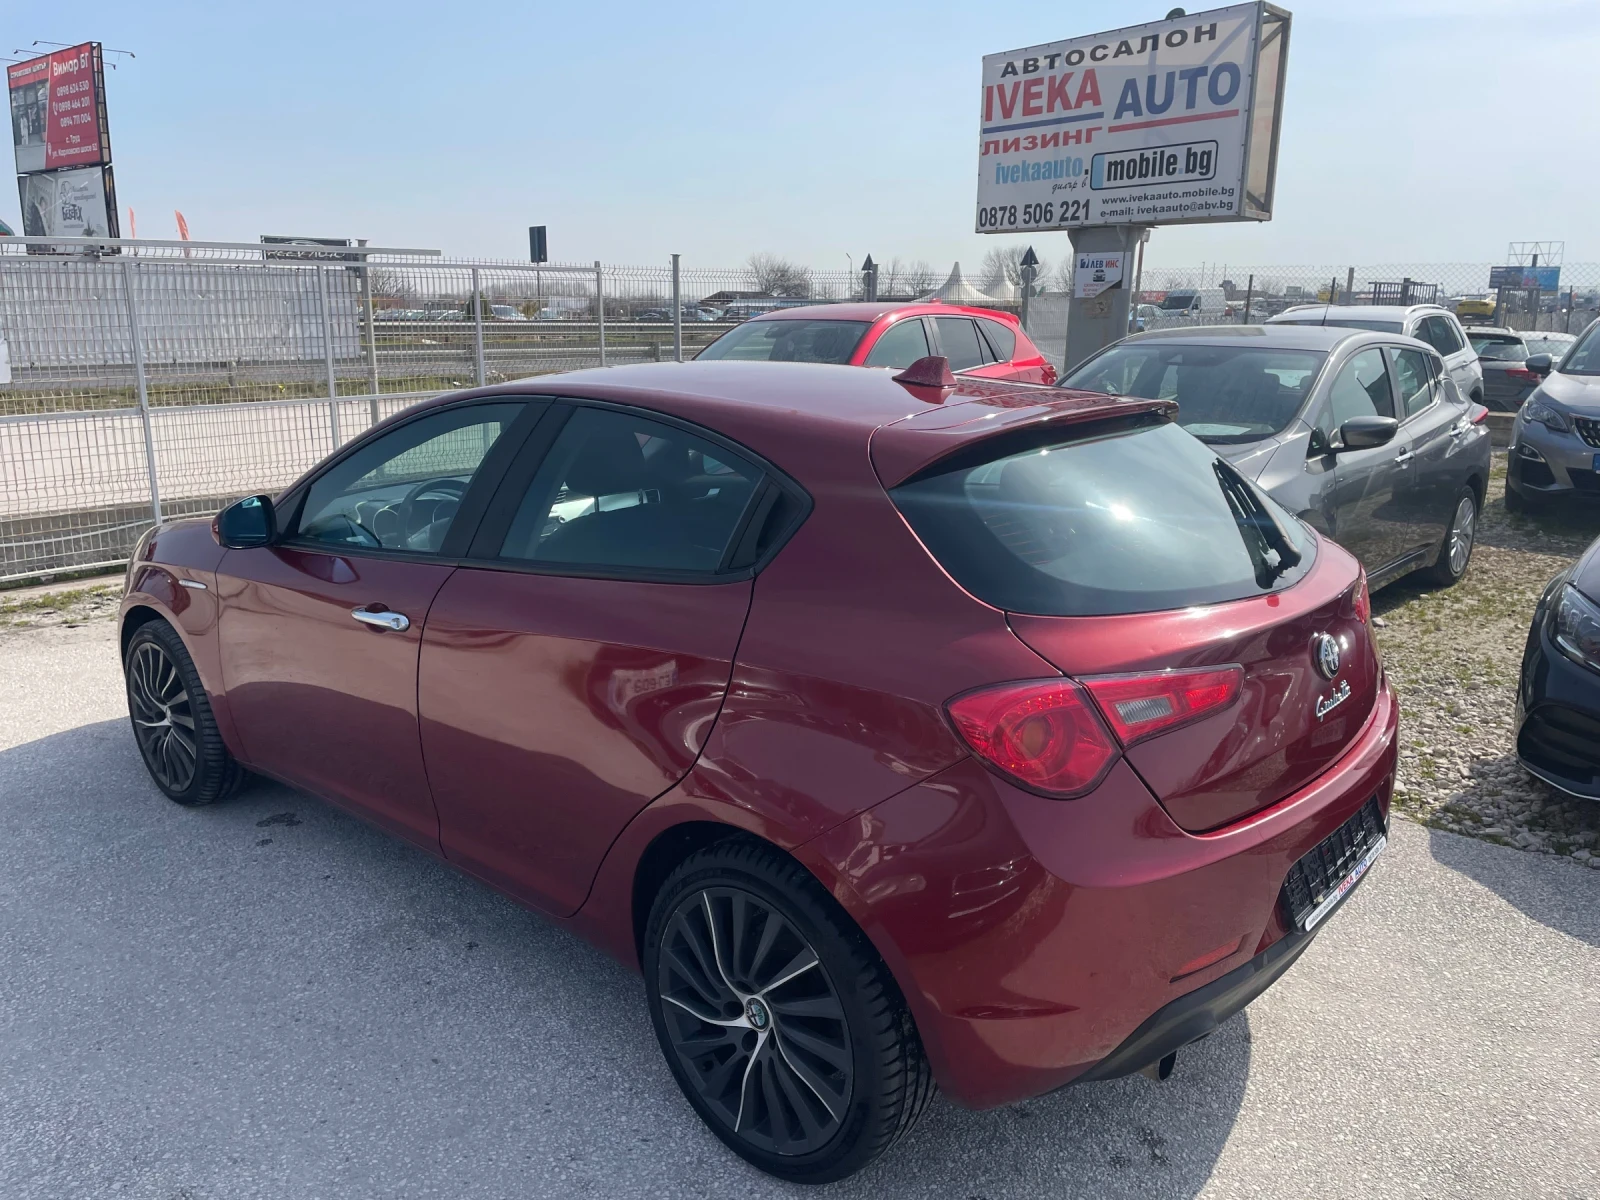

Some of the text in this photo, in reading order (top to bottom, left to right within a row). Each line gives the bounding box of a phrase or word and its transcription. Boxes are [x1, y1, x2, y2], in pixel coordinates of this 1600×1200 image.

[1000, 22, 1217, 78] АВТОСАЛОН
[985, 61, 1241, 122] IVEKA AUTO
[982, 127, 1102, 156] ЛИЗИНГ
[1106, 147, 1212, 182] mobile.bg
[1100, 199, 1234, 217] e-mail: ivekaauto@abv.bg
[1101, 186, 1235, 204] www.ivekaauto.mobile.bg
[979, 198, 1091, 227] 0878 506 221
[1090, 259, 1120, 269] ЛЕВ ИНС
[1337, 874, 1355, 895] IVEKA
[1354, 858, 1368, 879] AUTO
